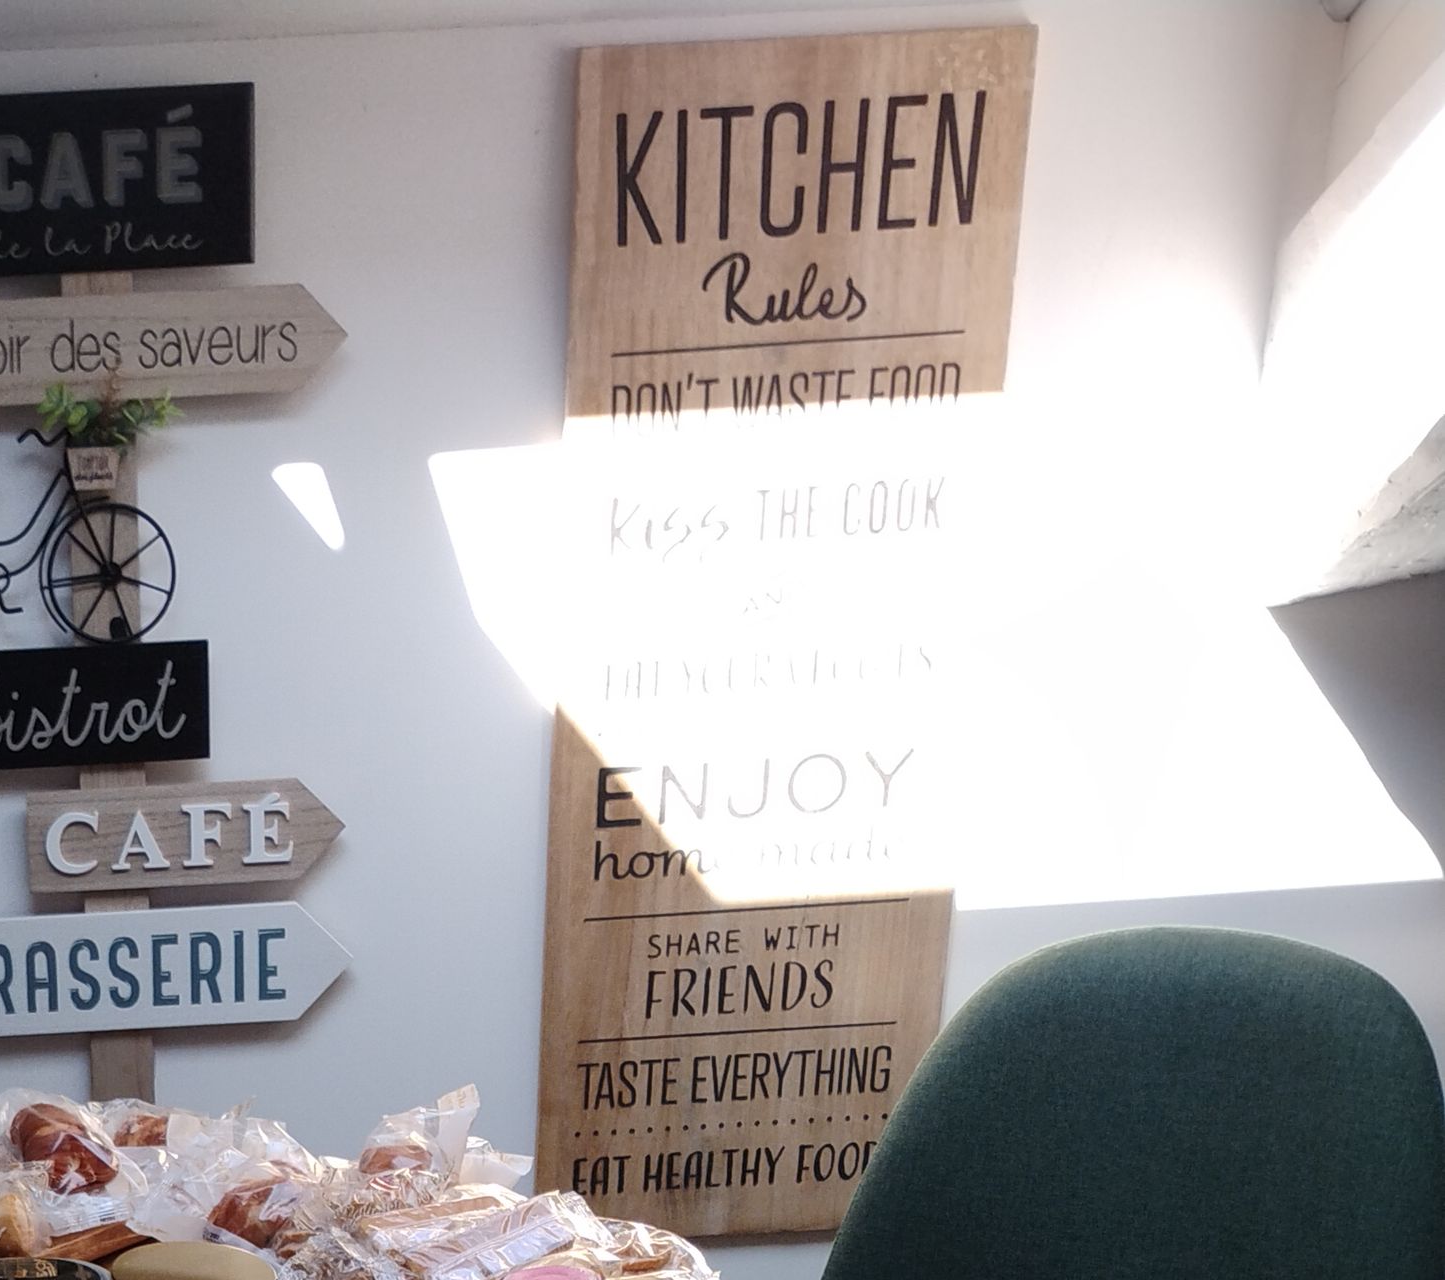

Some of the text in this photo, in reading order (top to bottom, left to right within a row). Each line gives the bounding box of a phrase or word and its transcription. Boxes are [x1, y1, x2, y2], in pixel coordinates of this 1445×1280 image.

[615, 90, 987, 247] KITCHEN
[44, 227, 93, 256] la
[104, 220, 204, 254] Place
[702, 252, 867, 325] Rules
[50, 318, 122, 374] des
[138, 319, 300, 370] saveurs
[756, 485, 818, 543] THE
[843, 476, 947, 536] COOK
[595, 748, 916, 829] ENJOY
[44, 792, 296, 875] CAFÉ
[647, 923, 841, 959] SHARE WITH
[645, 959, 835, 1019] FRIENDS
[577, 1045, 894, 1111] TASTE EVERYTHING
[572, 1155, 632, 1196] EAT
[642, 1145, 786, 1192] HEALTHY
